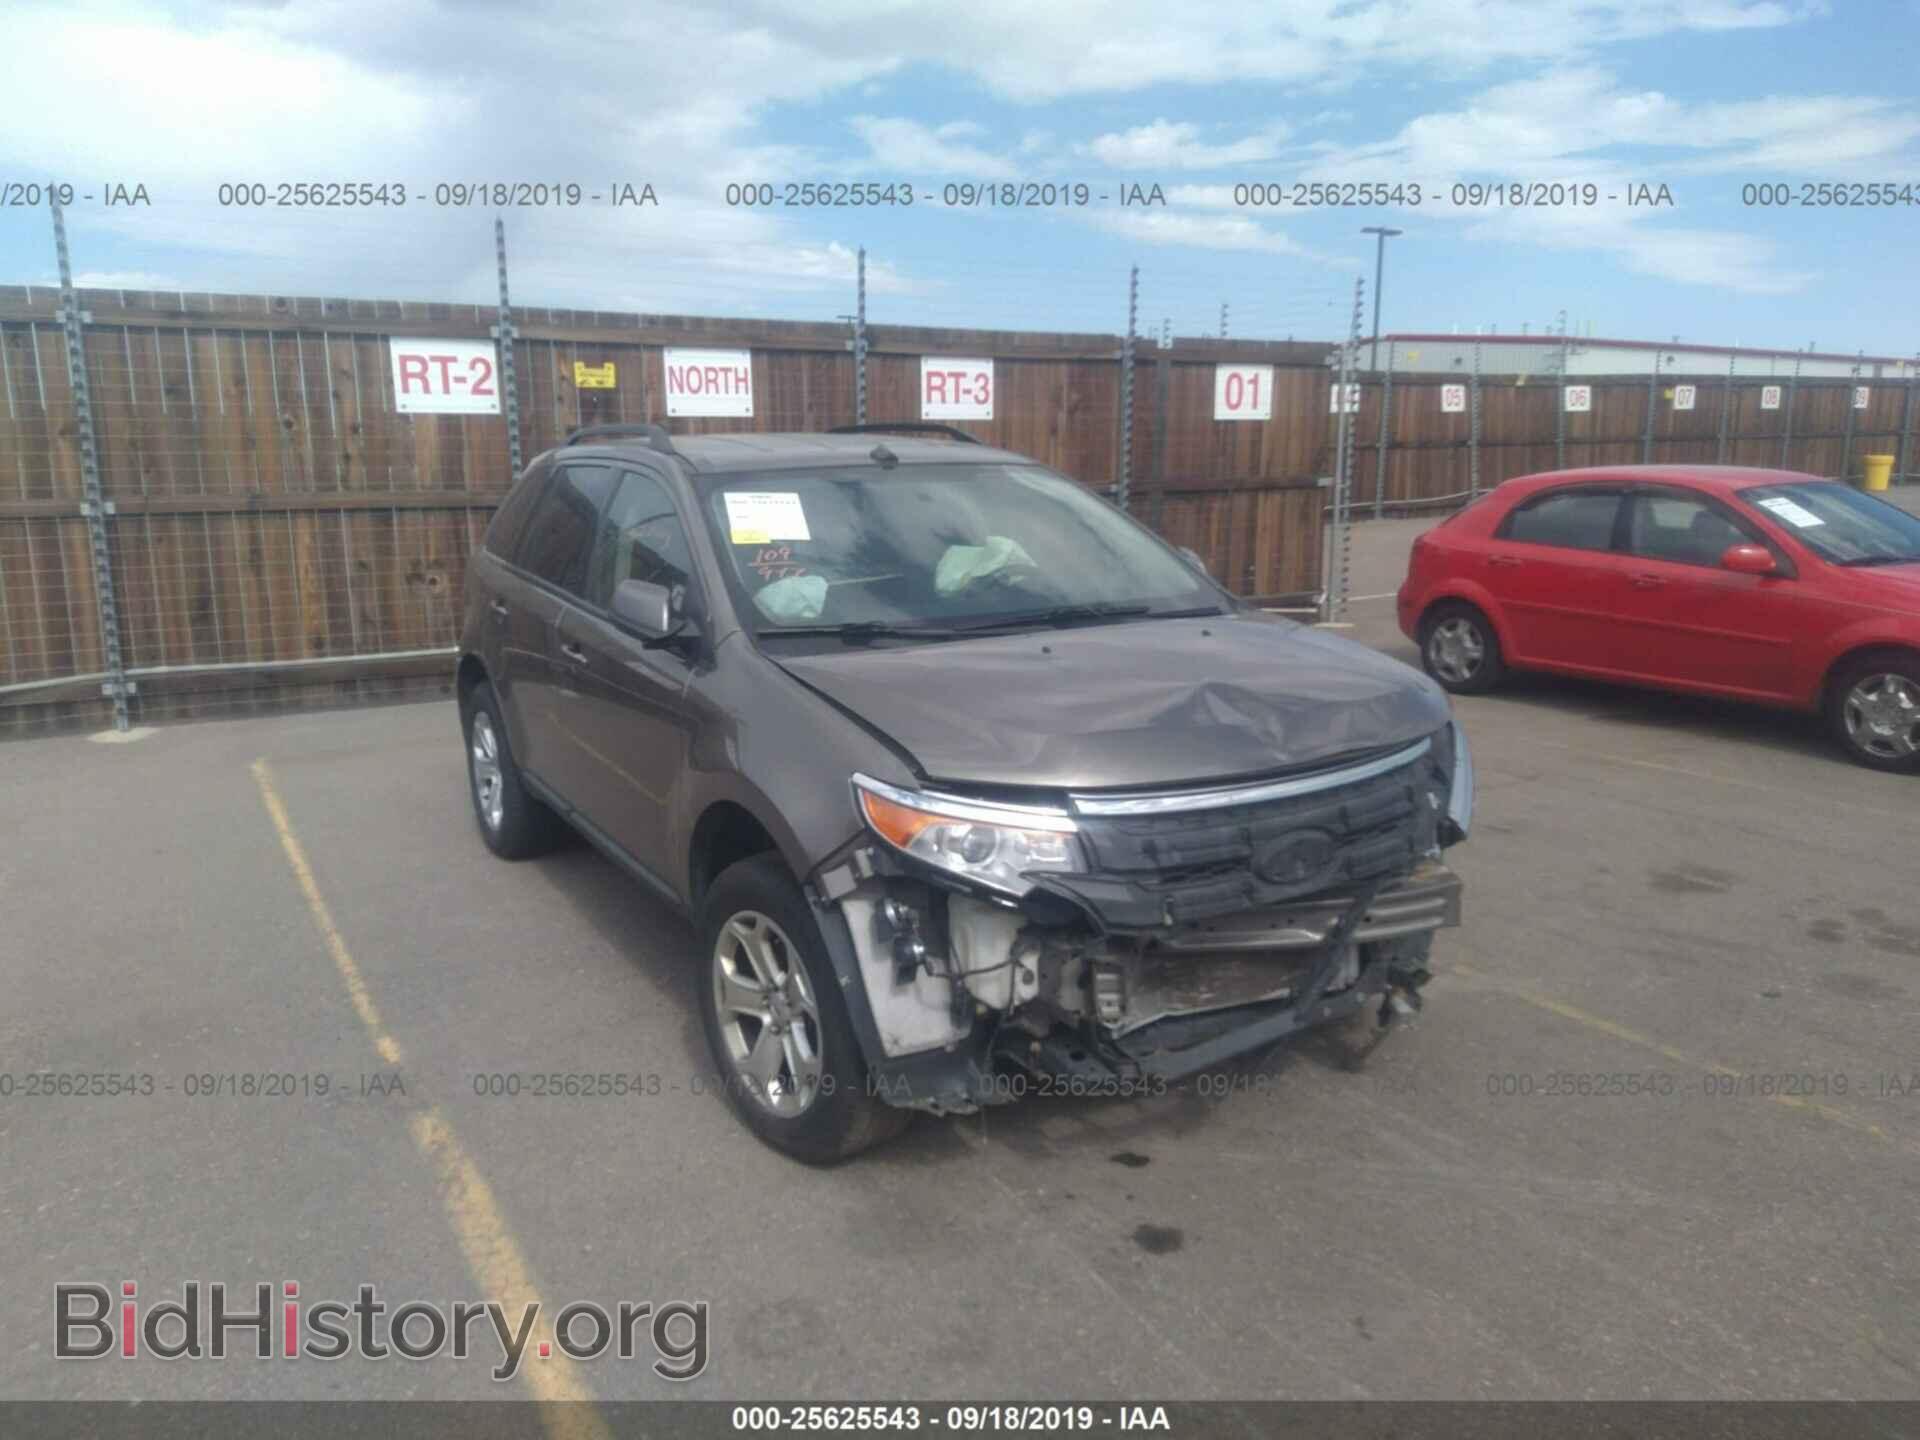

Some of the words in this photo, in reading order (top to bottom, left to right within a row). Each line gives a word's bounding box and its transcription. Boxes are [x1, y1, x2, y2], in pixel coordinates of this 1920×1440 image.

[399, 355, 495, 395] RT-2
[668, 366, 749, 394] NORTH
[926, 371, 990, 405] RT-3
[1225, 372, 1259, 410] 01
[1446, 388, 1461, 407] 05
[1569, 390, 1586, 407] 06
[1678, 388, 1692, 406] 07
